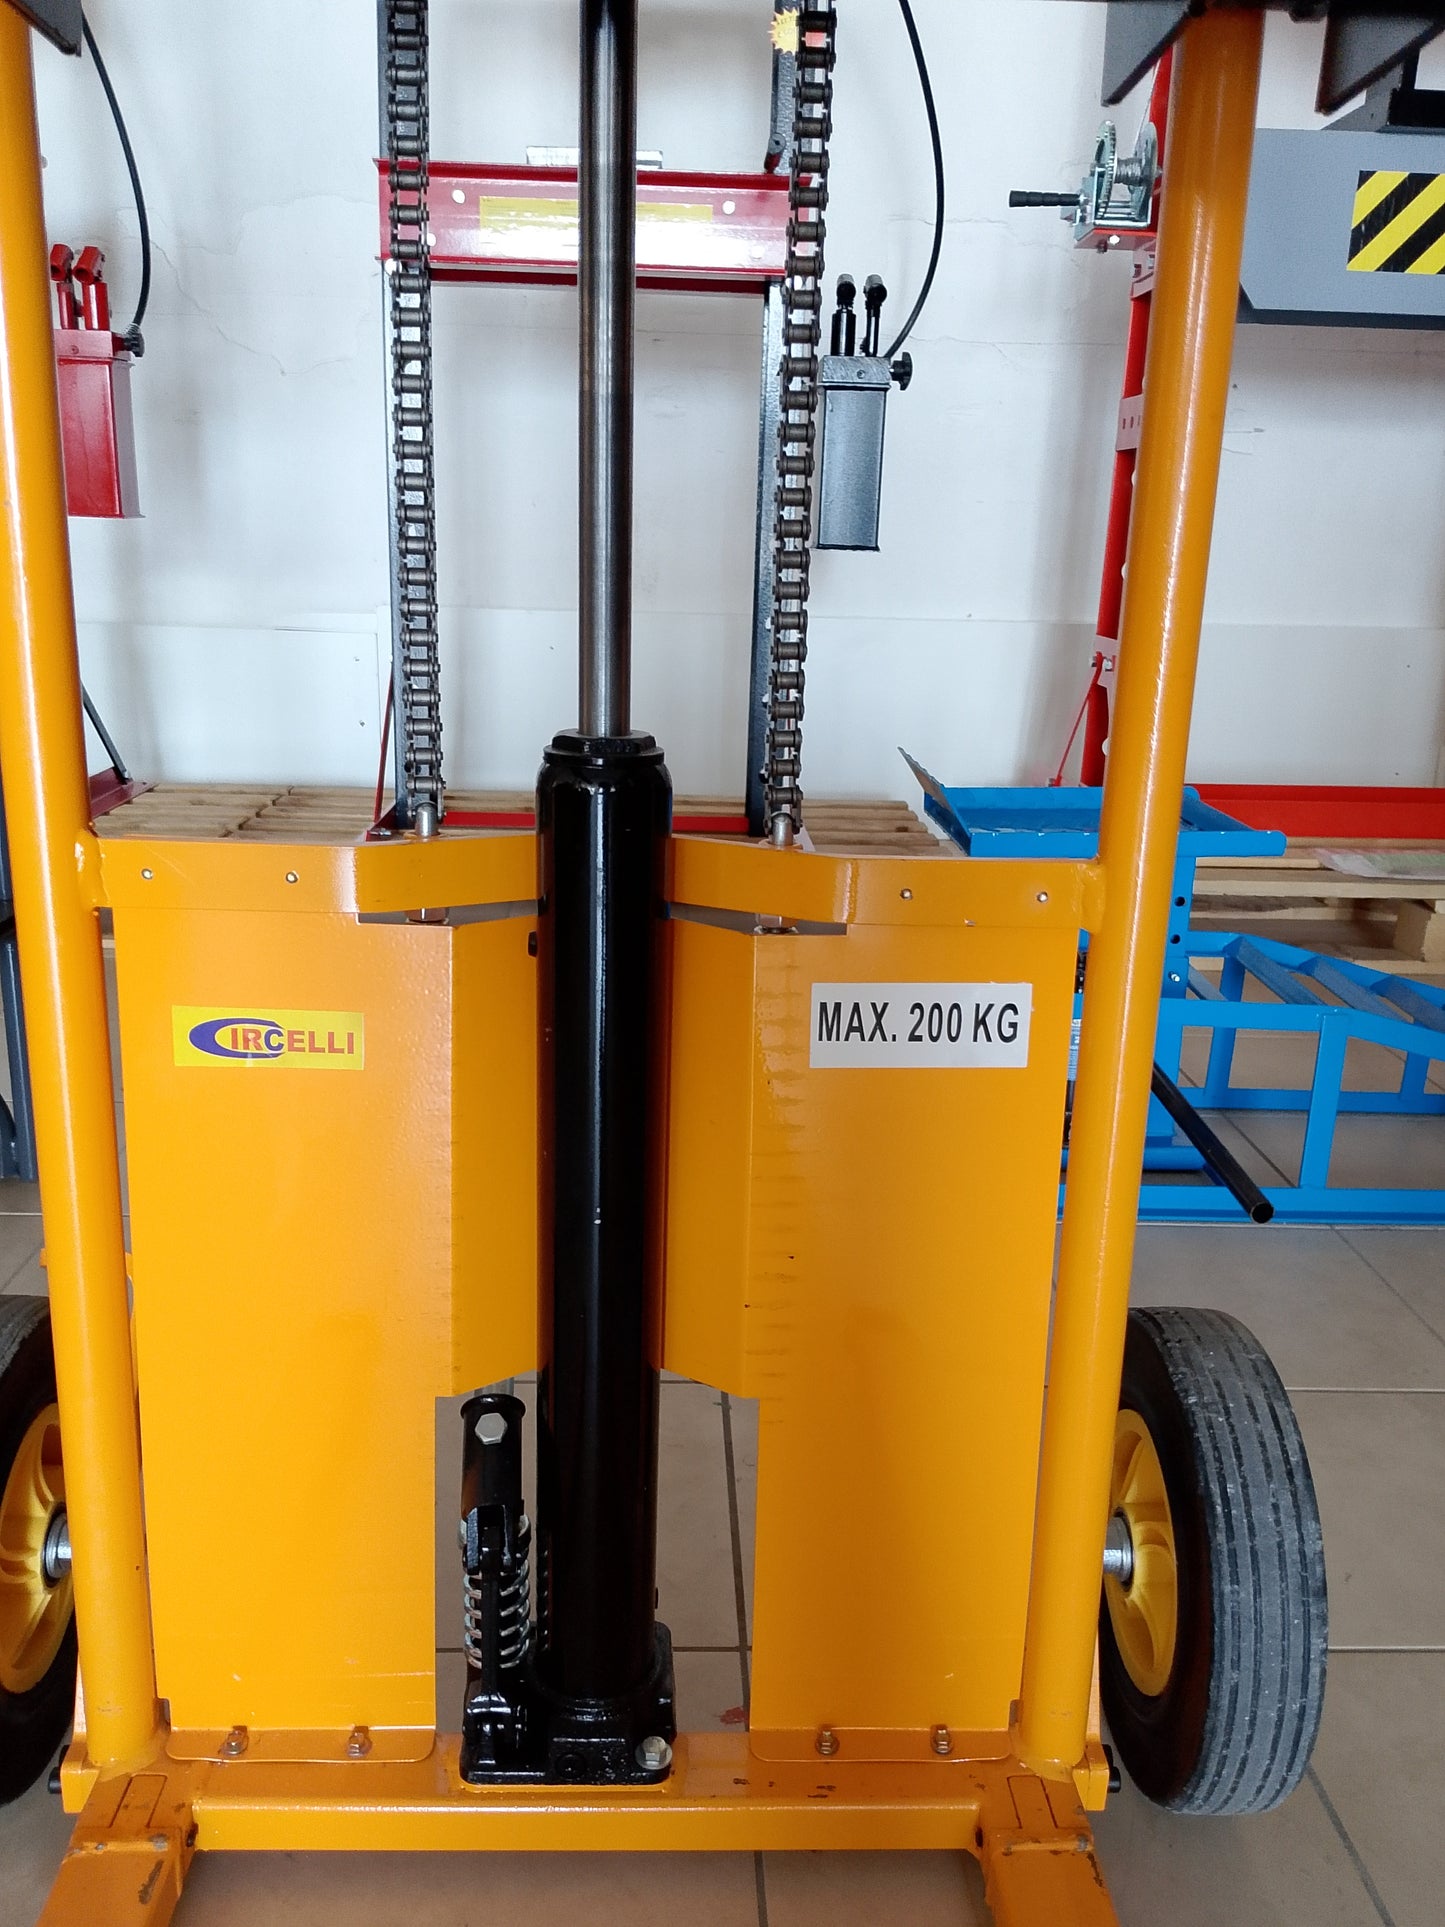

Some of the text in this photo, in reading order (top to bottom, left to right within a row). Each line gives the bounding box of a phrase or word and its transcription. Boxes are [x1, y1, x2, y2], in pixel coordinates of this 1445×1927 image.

[188, 1017, 355, 1060] CIRCELLI
[817, 1001, 1019, 1044] MAX. 200 KG
